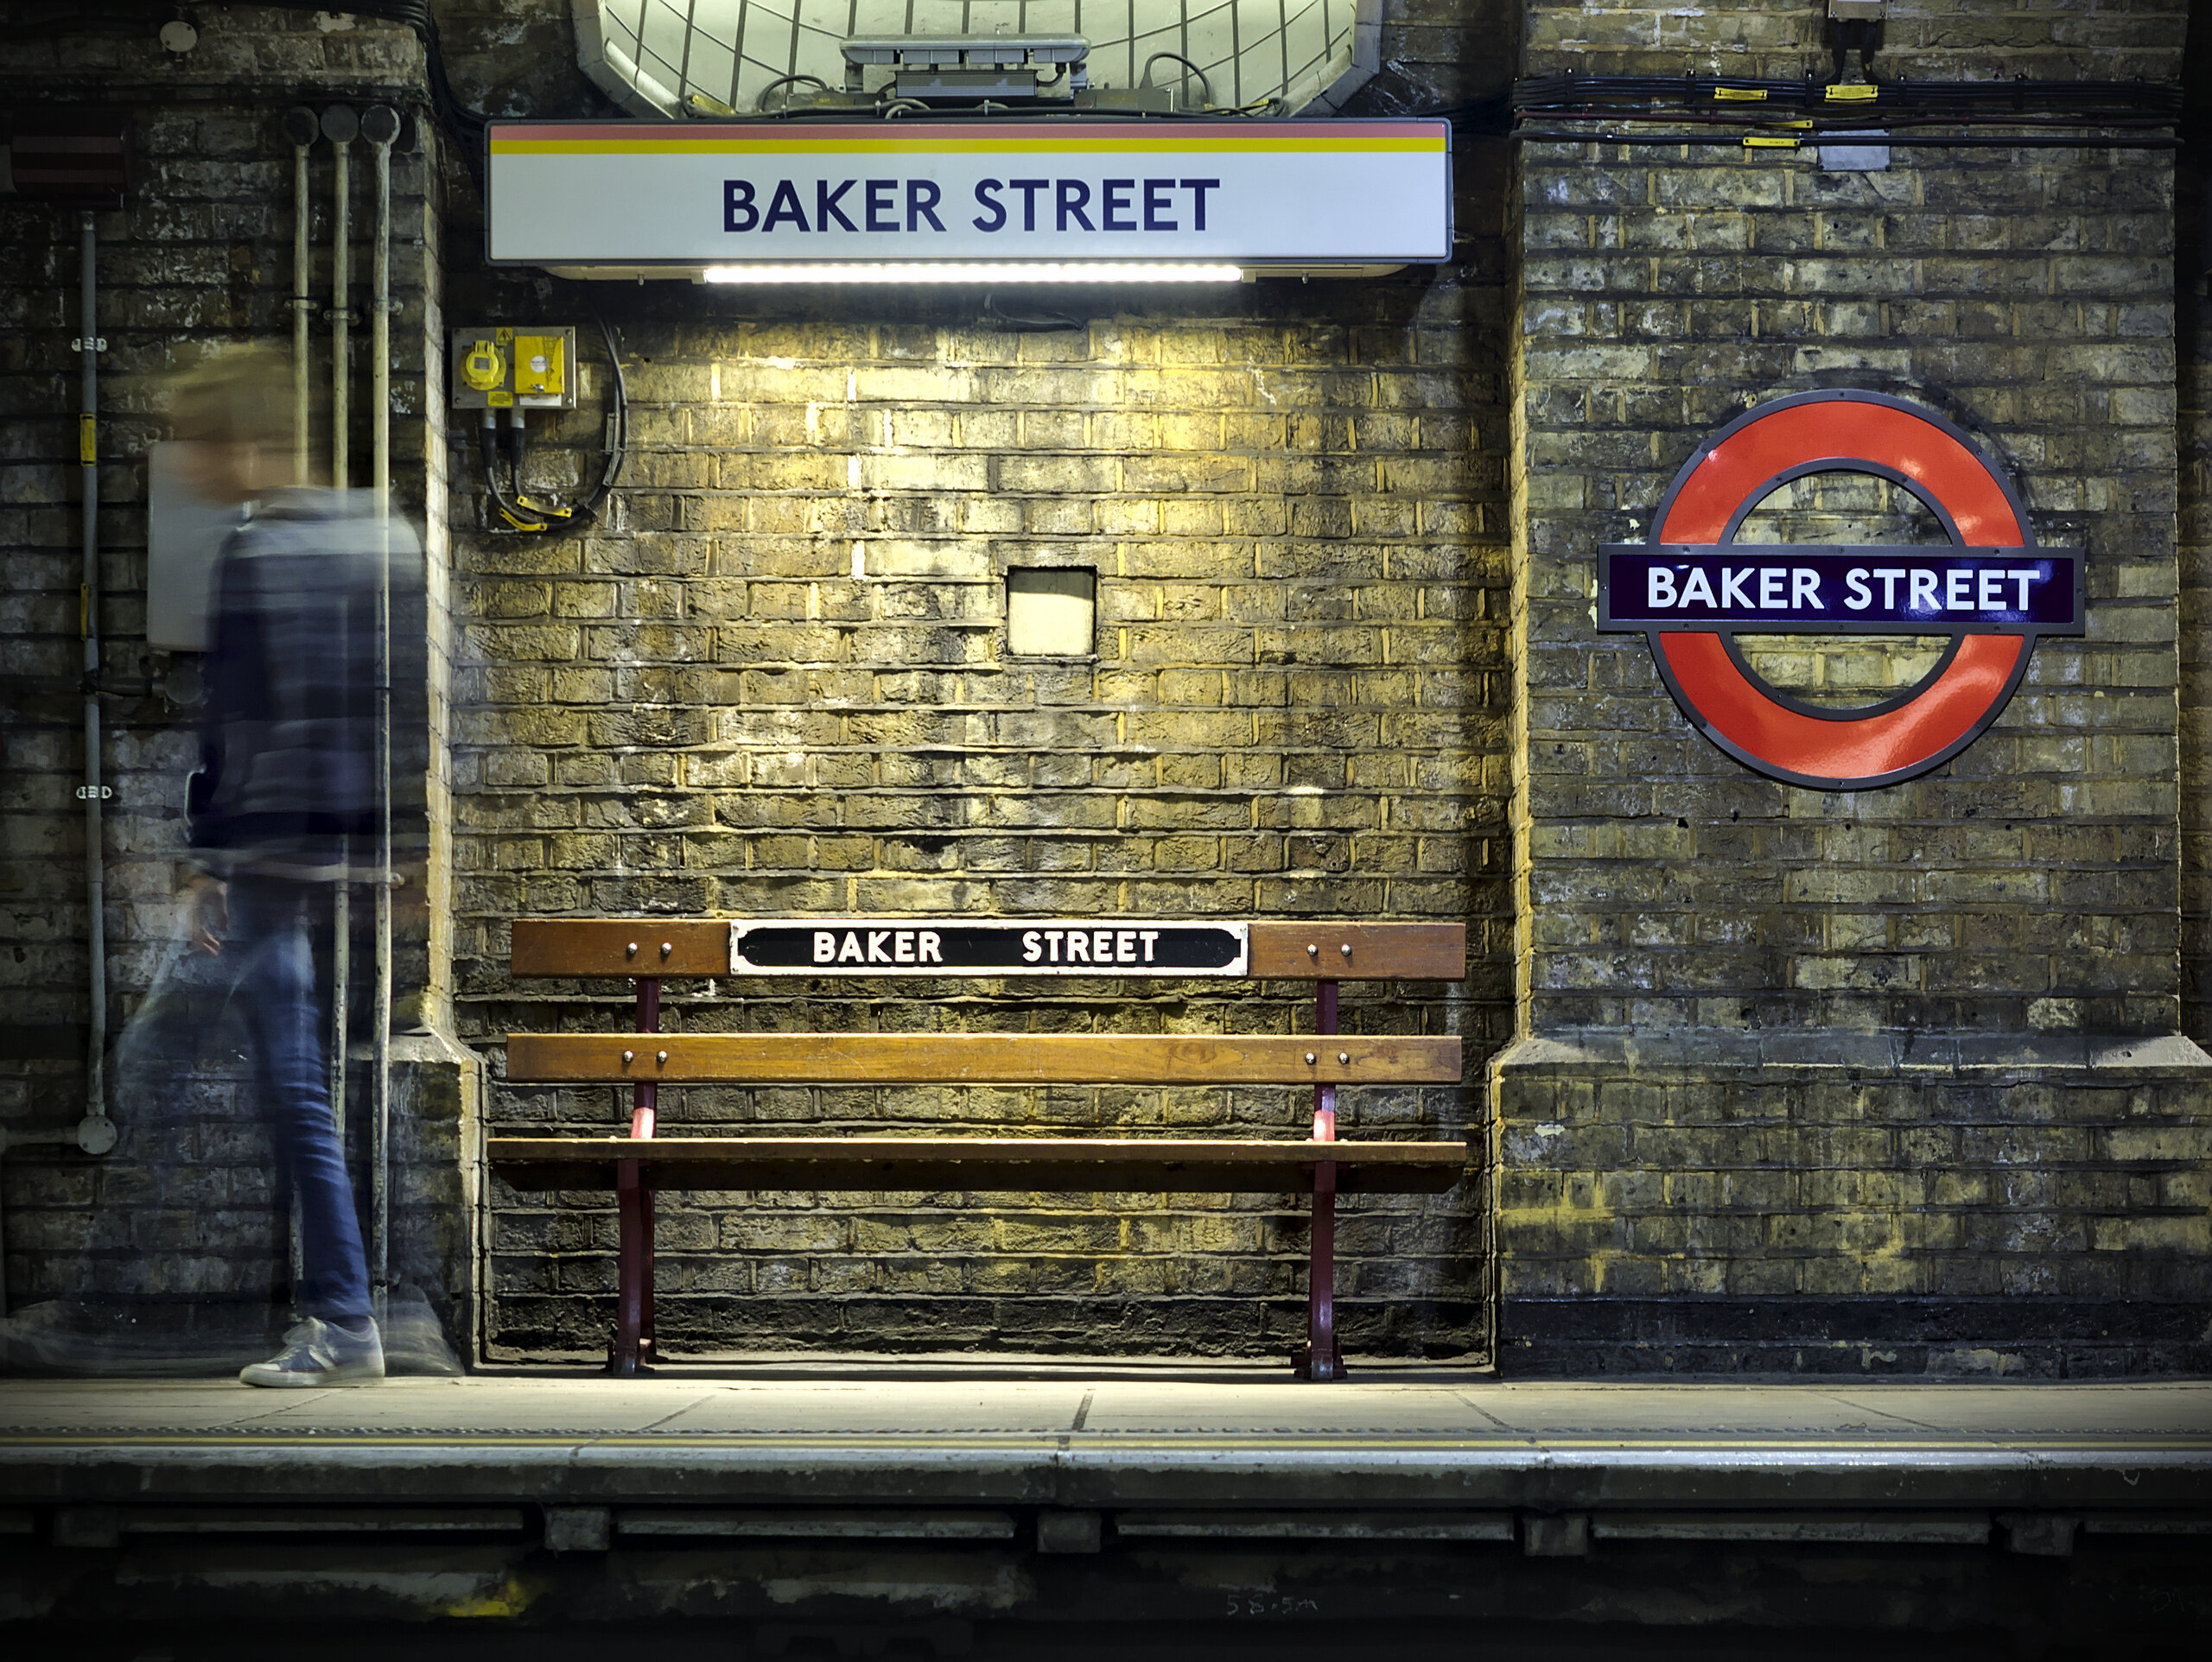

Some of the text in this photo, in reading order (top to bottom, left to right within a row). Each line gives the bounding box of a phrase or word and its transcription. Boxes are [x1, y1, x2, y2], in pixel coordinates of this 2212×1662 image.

[724, 178, 1221, 233] BAKER STREET
[1648, 567, 2041, 612] BAKER STREET
[813, 930, 1160, 963] BAKER STREET
